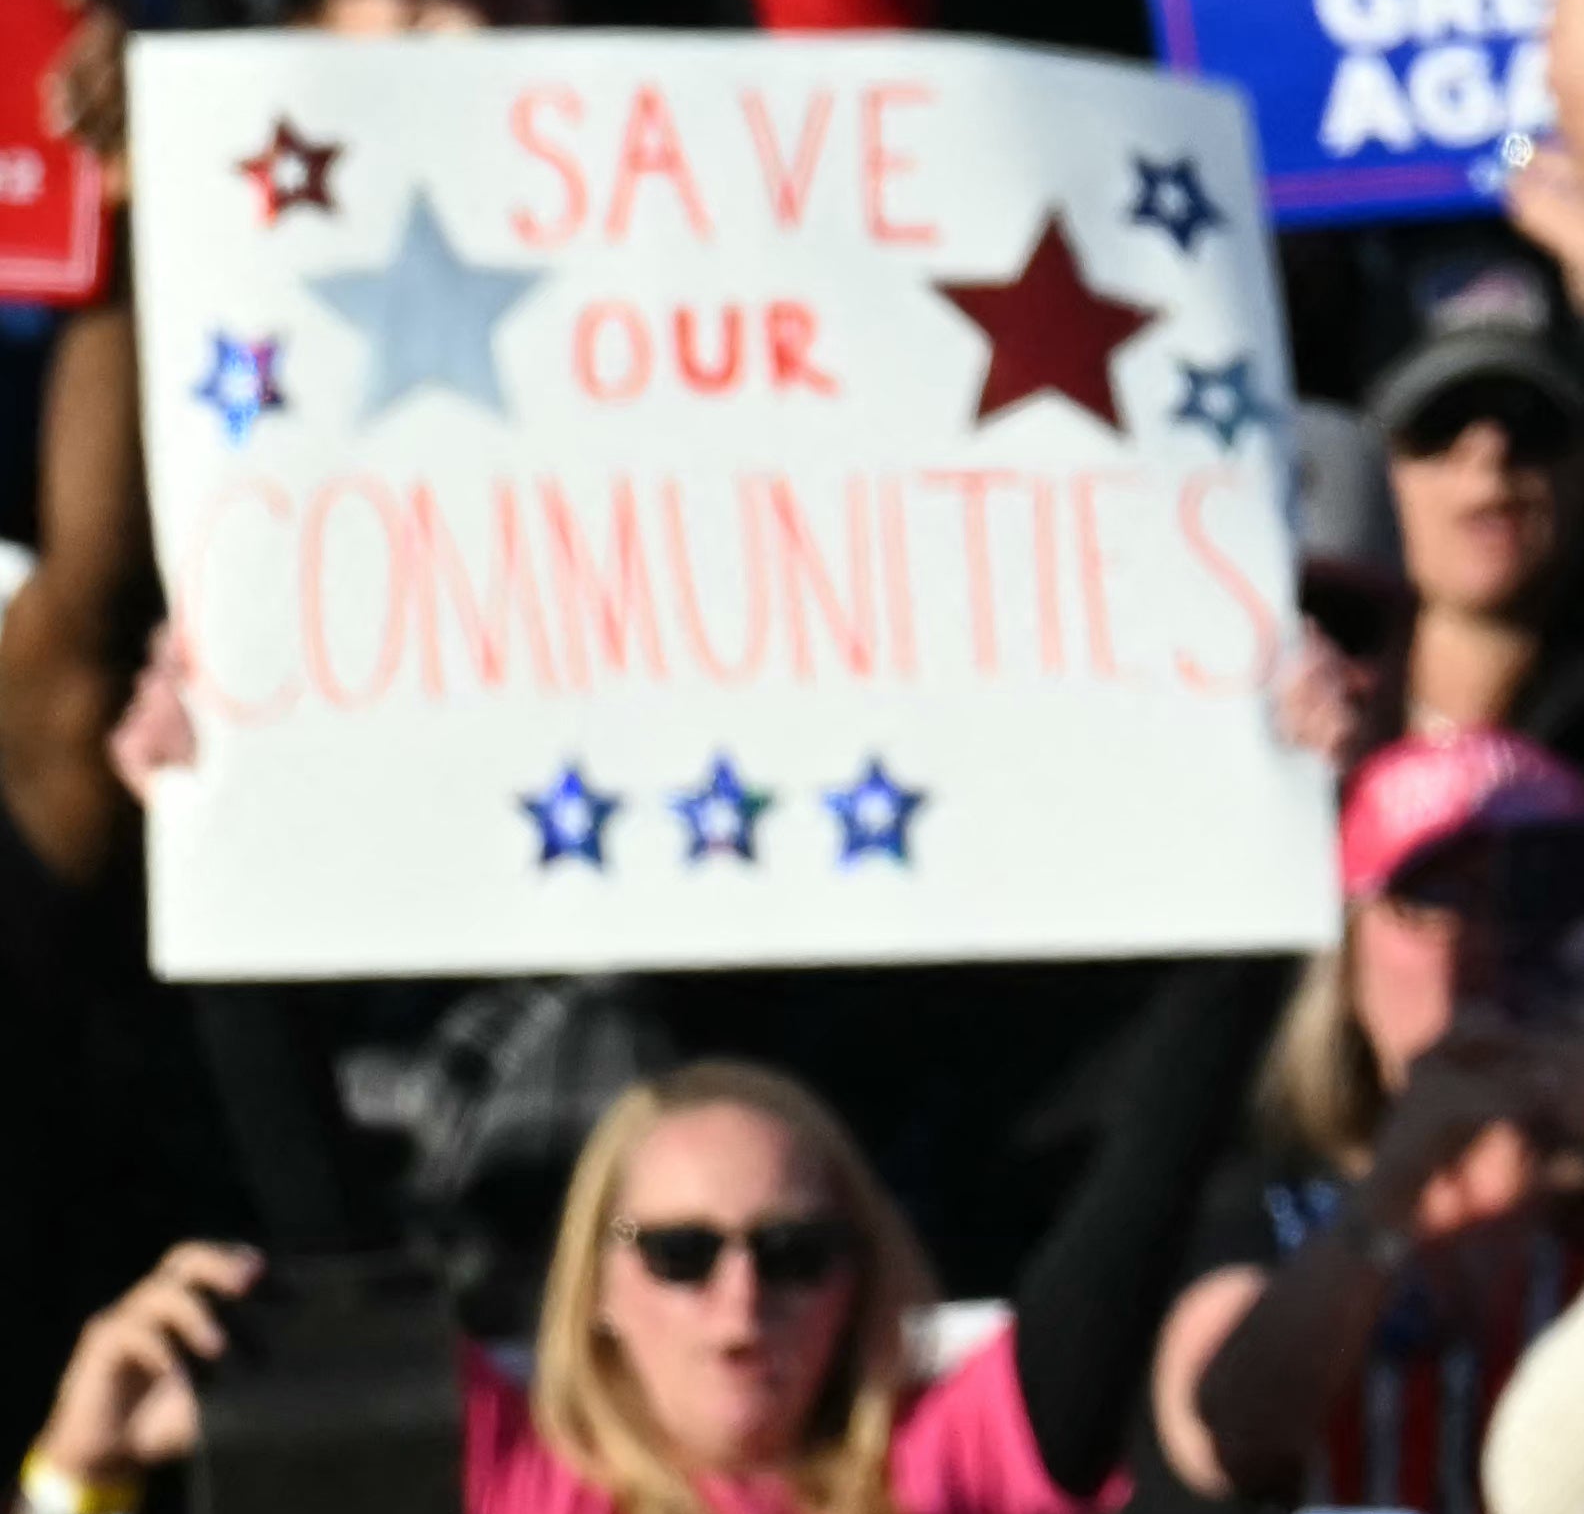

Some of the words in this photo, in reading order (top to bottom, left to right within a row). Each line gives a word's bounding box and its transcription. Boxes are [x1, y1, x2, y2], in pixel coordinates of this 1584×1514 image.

[508, 81, 943, 247] SAVE
[1320, 45, 1560, 157] AGA
[572, 297, 840, 401] OUR
[184, 465, 1280, 721] COMMUNITIES
